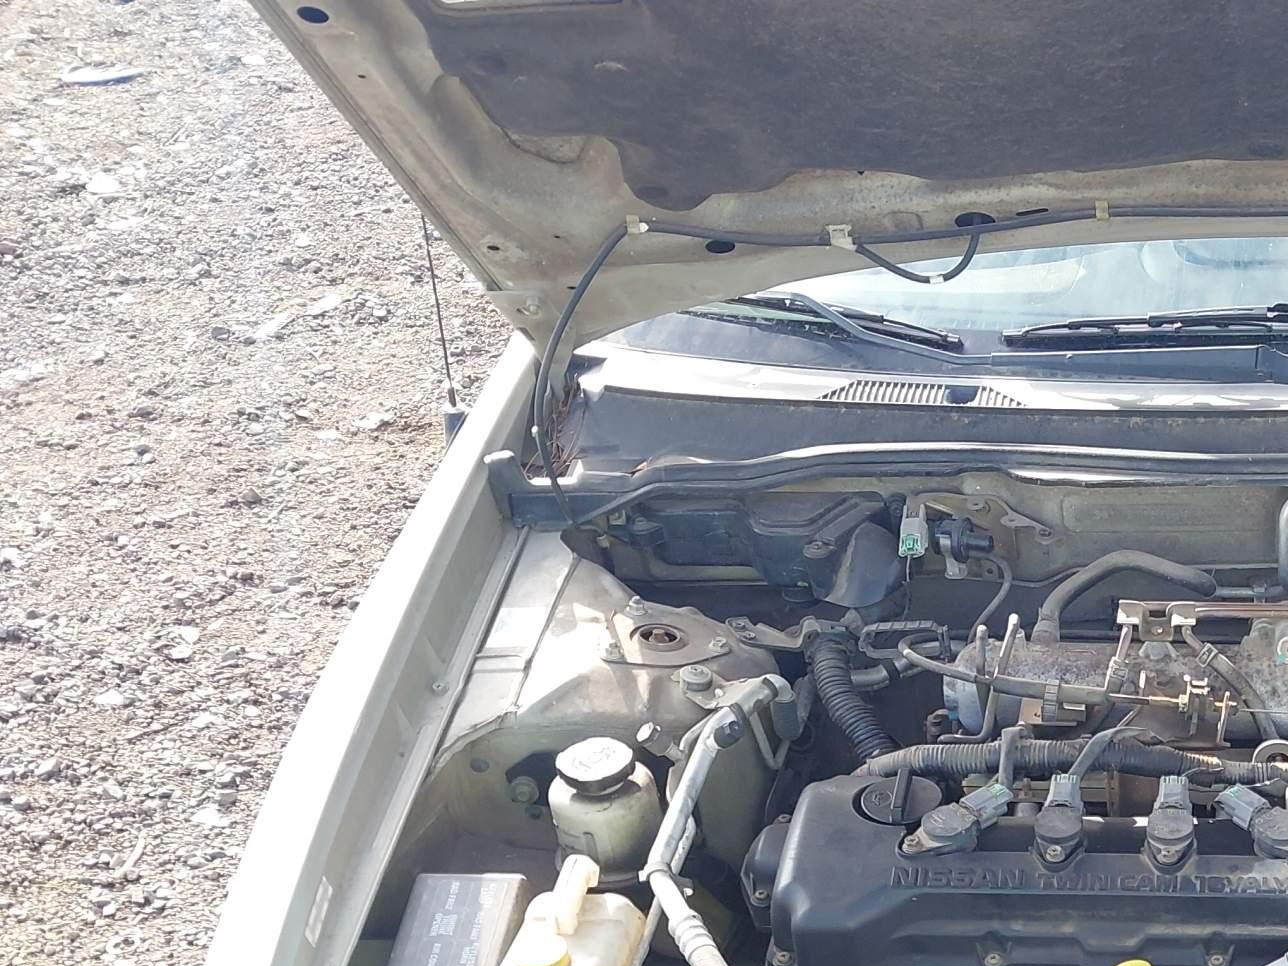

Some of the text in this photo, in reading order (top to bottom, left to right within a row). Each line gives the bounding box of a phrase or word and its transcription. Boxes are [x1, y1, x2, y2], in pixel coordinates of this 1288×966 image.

[890, 866, 1025, 889] NISSAN
[1036, 872, 1111, 891] TWIN
[1118, 874, 1181, 893] CAM
